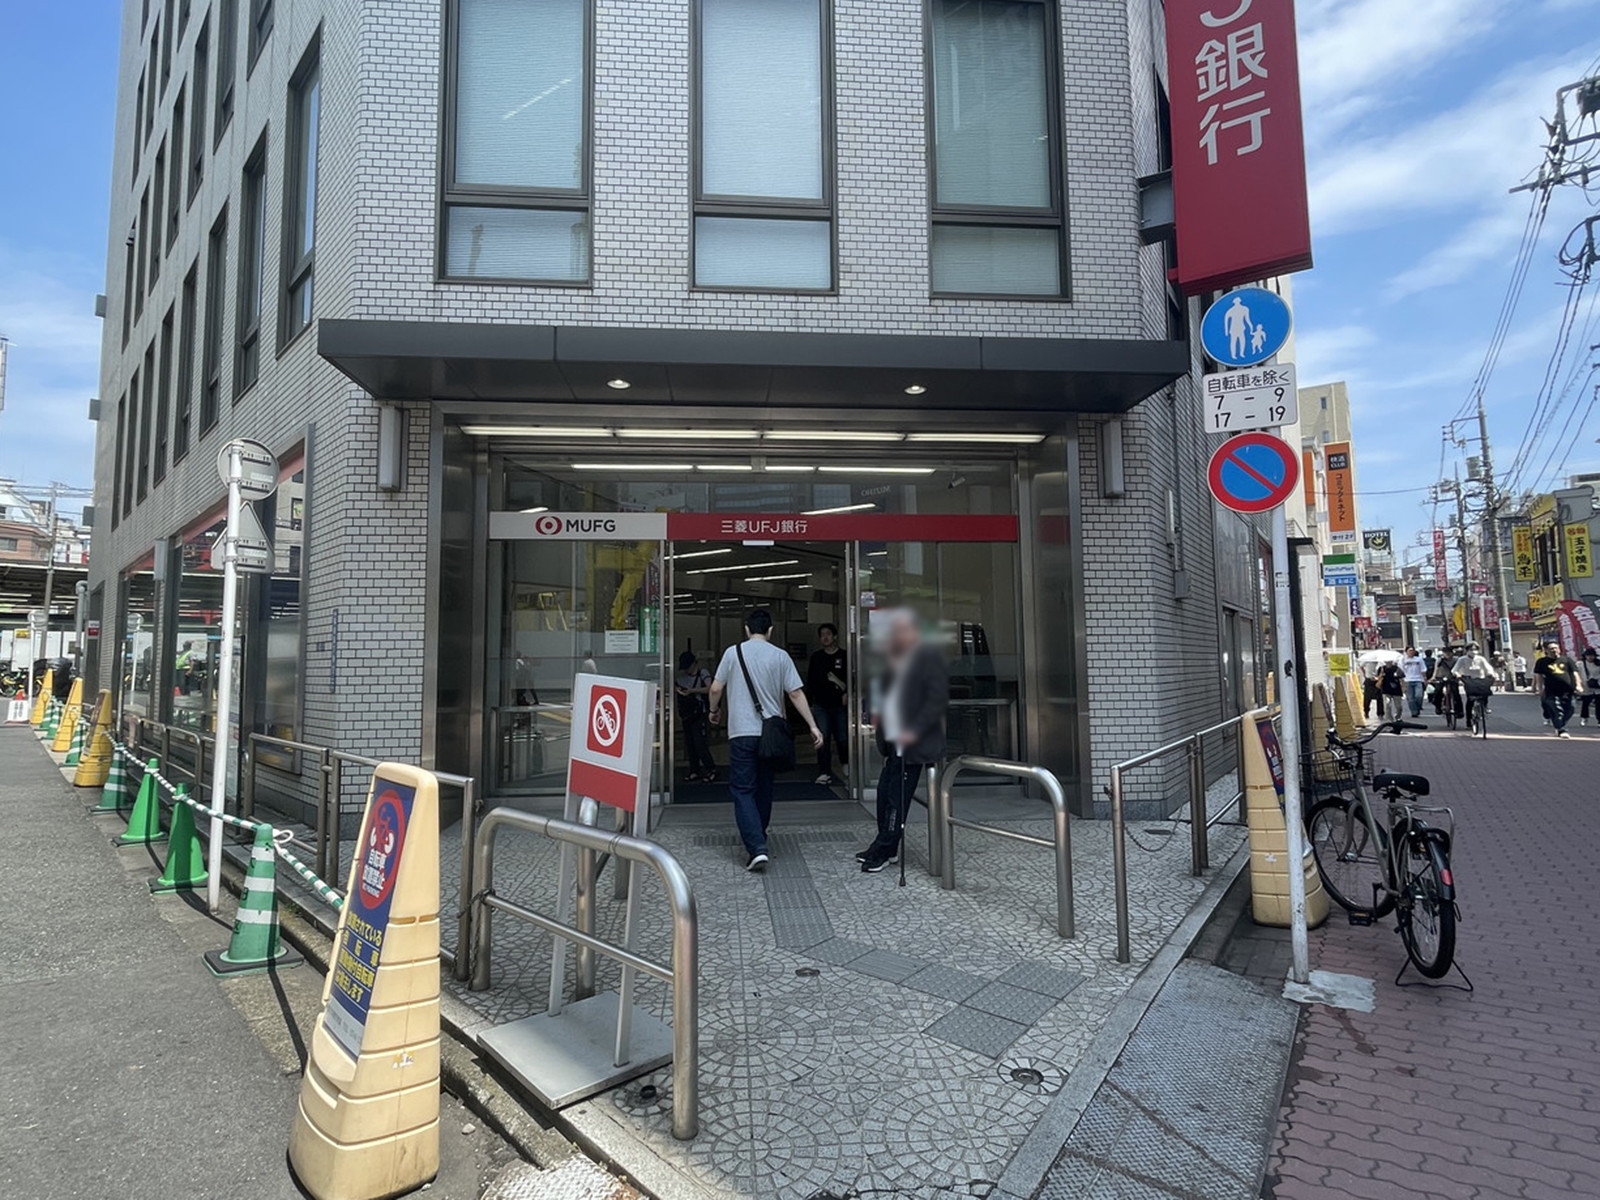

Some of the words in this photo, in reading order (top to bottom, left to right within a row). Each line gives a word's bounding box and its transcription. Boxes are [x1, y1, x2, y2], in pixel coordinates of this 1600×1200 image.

[1208, 370, 1289, 393] 自転車を除く
[1214, 395, 1225, 410] 7
[1274, 387, 1285, 402] 9
[1214, 412, 1231, 428] 17
[1269, 406, 1286, 422] 19
[566, 519, 616, 532] MUFG
[721, 519, 808, 534] 三菱UFJ銀行
[368, 849, 387, 870] 自転車
